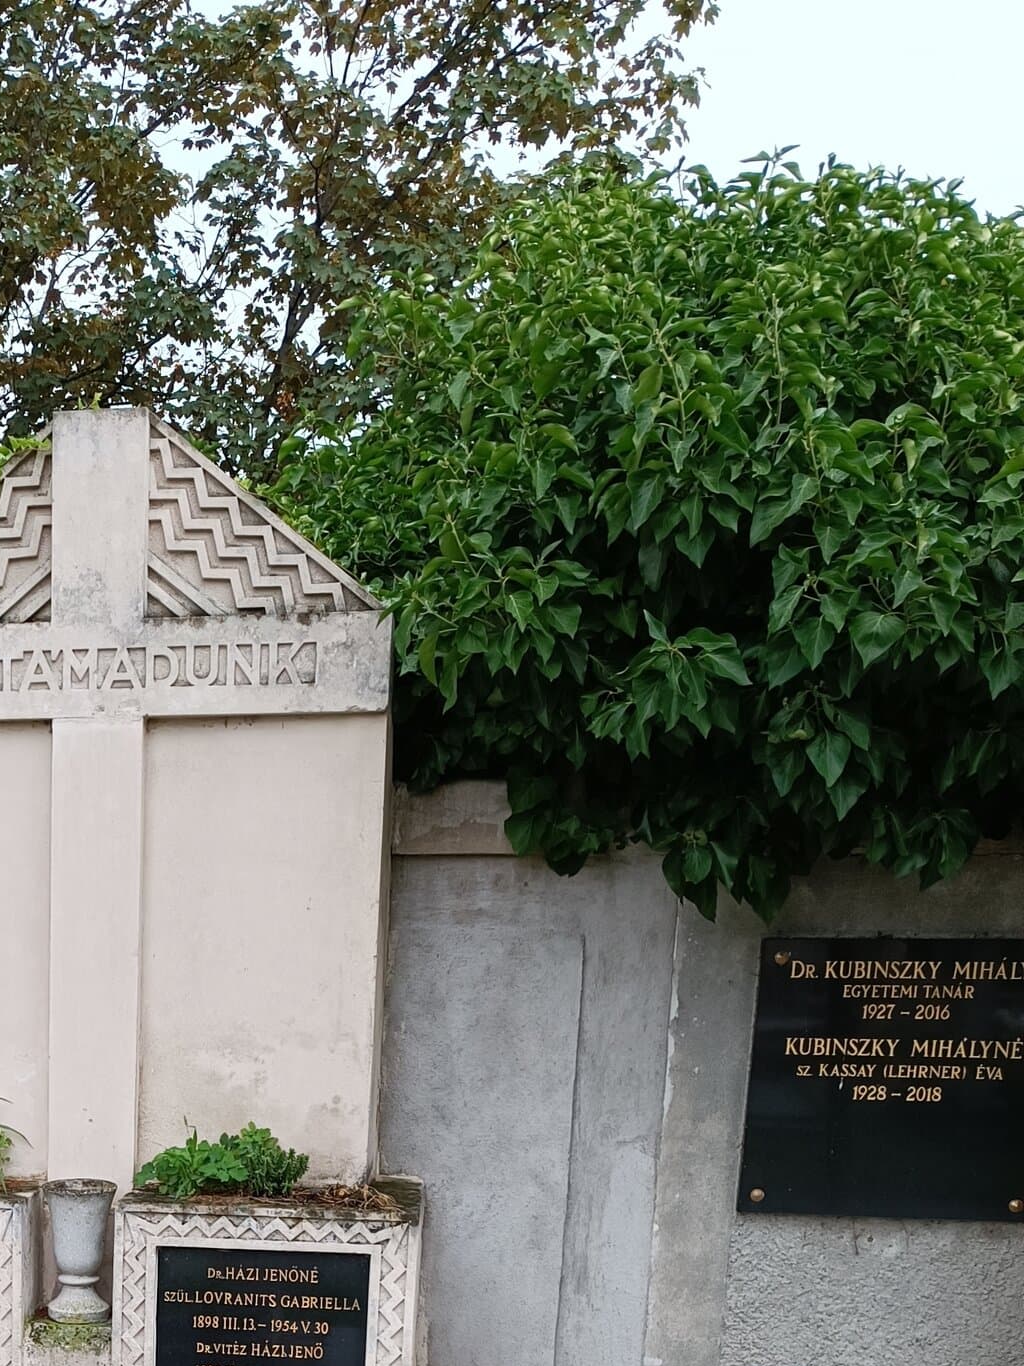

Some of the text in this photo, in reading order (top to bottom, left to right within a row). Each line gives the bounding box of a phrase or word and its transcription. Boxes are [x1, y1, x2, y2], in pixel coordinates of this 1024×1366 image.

[824, 960, 942, 980] KUBINSZKY
[952, 956, 1024, 981] MIHÁL
[843, 981, 975, 999] EGYETEMI TANÁR
[862, 1003, 896, 1020] 1927
[914, 1004, 951, 1020] 2016
[784, 1037, 1024, 1060] KUBINSZKY MIHÁLYNÉ
[818, 1063, 877, 1078] KASSAY
[883, 1064, 967, 1080] (LEHRNER)
[975, 1063, 1004, 1081] ÉVA
[852, 1084, 887, 1101] 1928
[905, 1085, 943, 1102] 2018
[225, 1264, 259, 1281] HÁZI
[194, 1290, 277, 1308] LOVRANITS
[280, 1294, 361, 1311] GABRIELLA
[192, 1315, 220, 1329] 1898
[222, 1316, 241, 1331] III.
[270, 1319, 299, 1334] 1954
[300, 1320, 311, 1334] V.
[313, 1321, 330, 1335] 30
